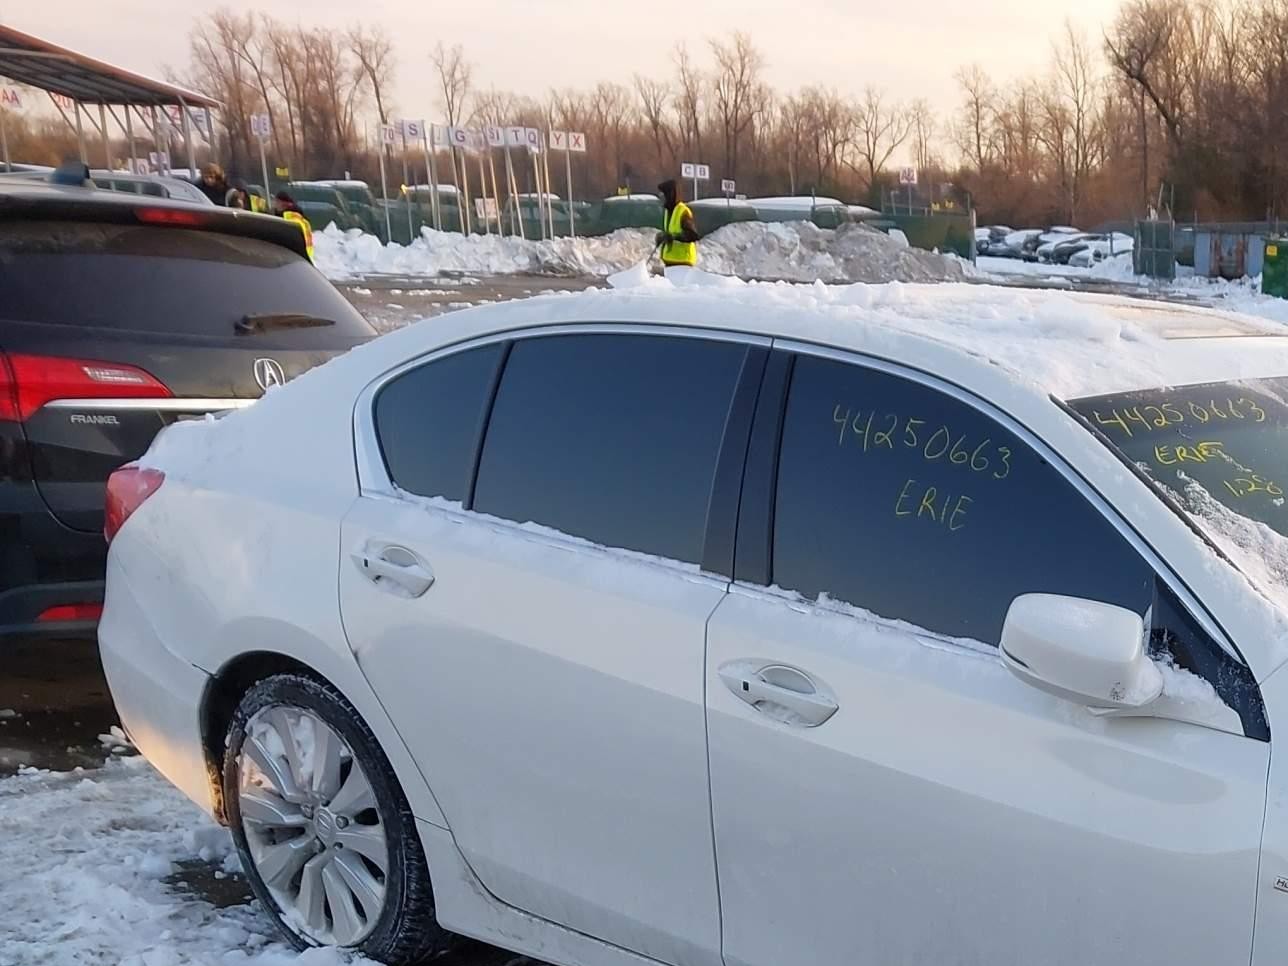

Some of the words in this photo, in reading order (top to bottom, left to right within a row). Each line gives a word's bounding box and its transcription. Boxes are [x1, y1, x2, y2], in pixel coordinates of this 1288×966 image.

[408, 123, 418, 136] S
[455, 129, 466, 142] G
[512, 129, 520, 142] T
[553, 132, 562, 145] Y
[572, 134, 582, 147] X
[70, 414, 120, 425] FRANKEL
[1093, 398, 1265, 437] 44250663
[833, 404, 1013, 479] 44250663
[1155, 441, 1224, 465] ERIE
[895, 479, 975, 531] ERIE
